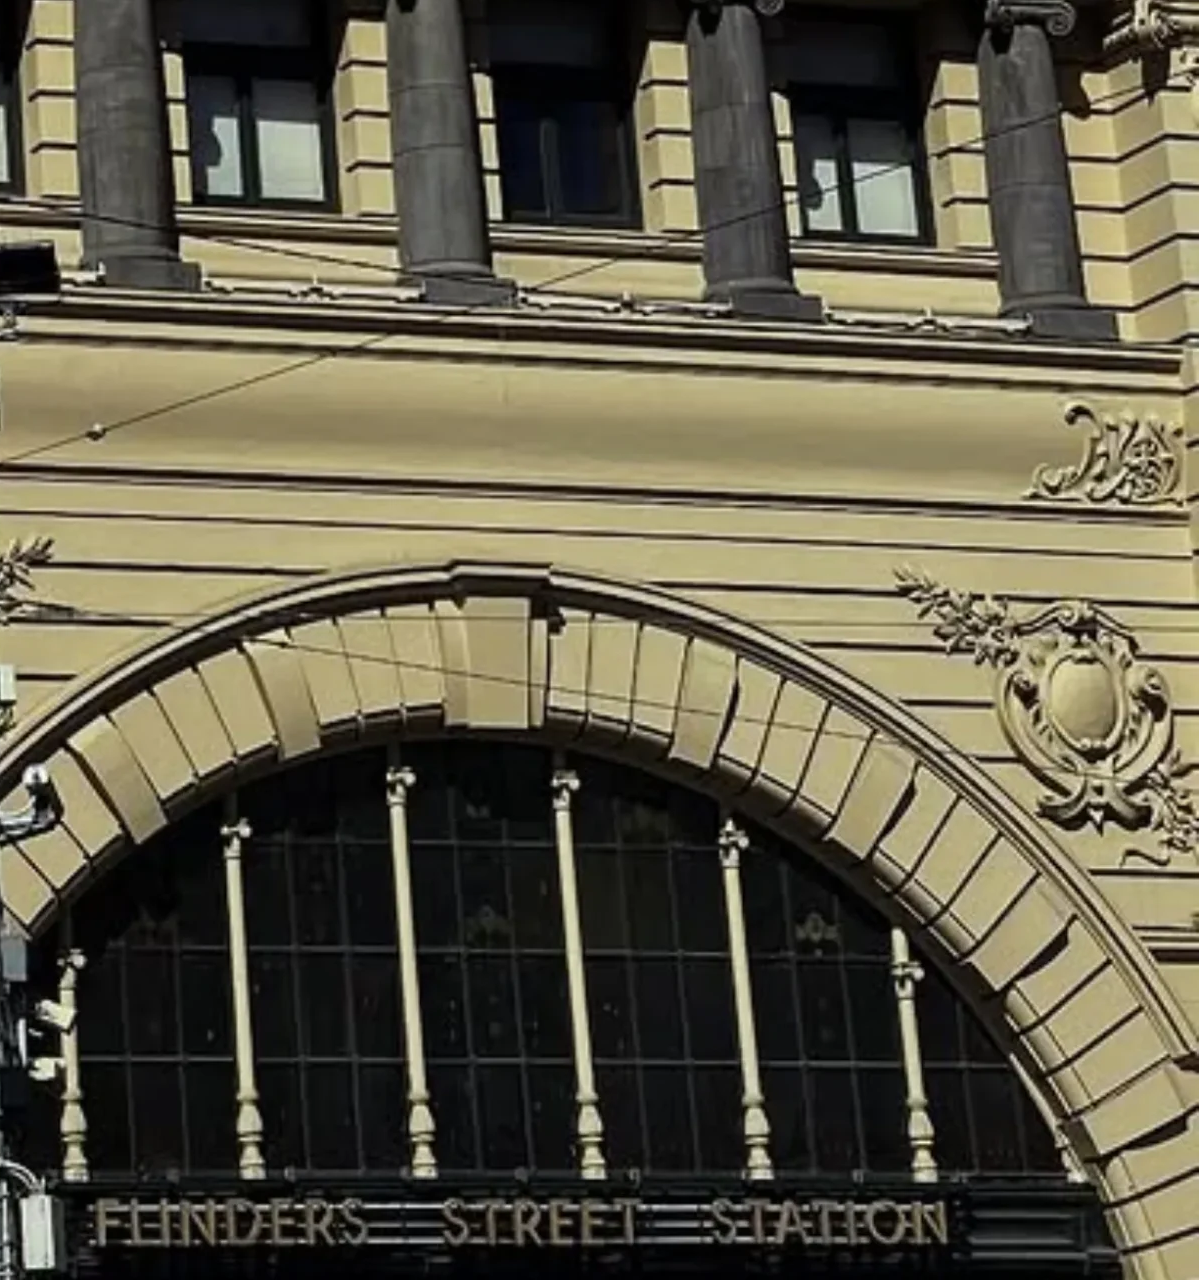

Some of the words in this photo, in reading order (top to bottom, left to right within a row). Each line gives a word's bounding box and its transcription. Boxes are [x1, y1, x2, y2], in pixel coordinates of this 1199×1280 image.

[95, 1197, 368, 1247] FLINDERS
[441, 1197, 642, 1247] STREET
[710, 1197, 949, 1246] STATION
